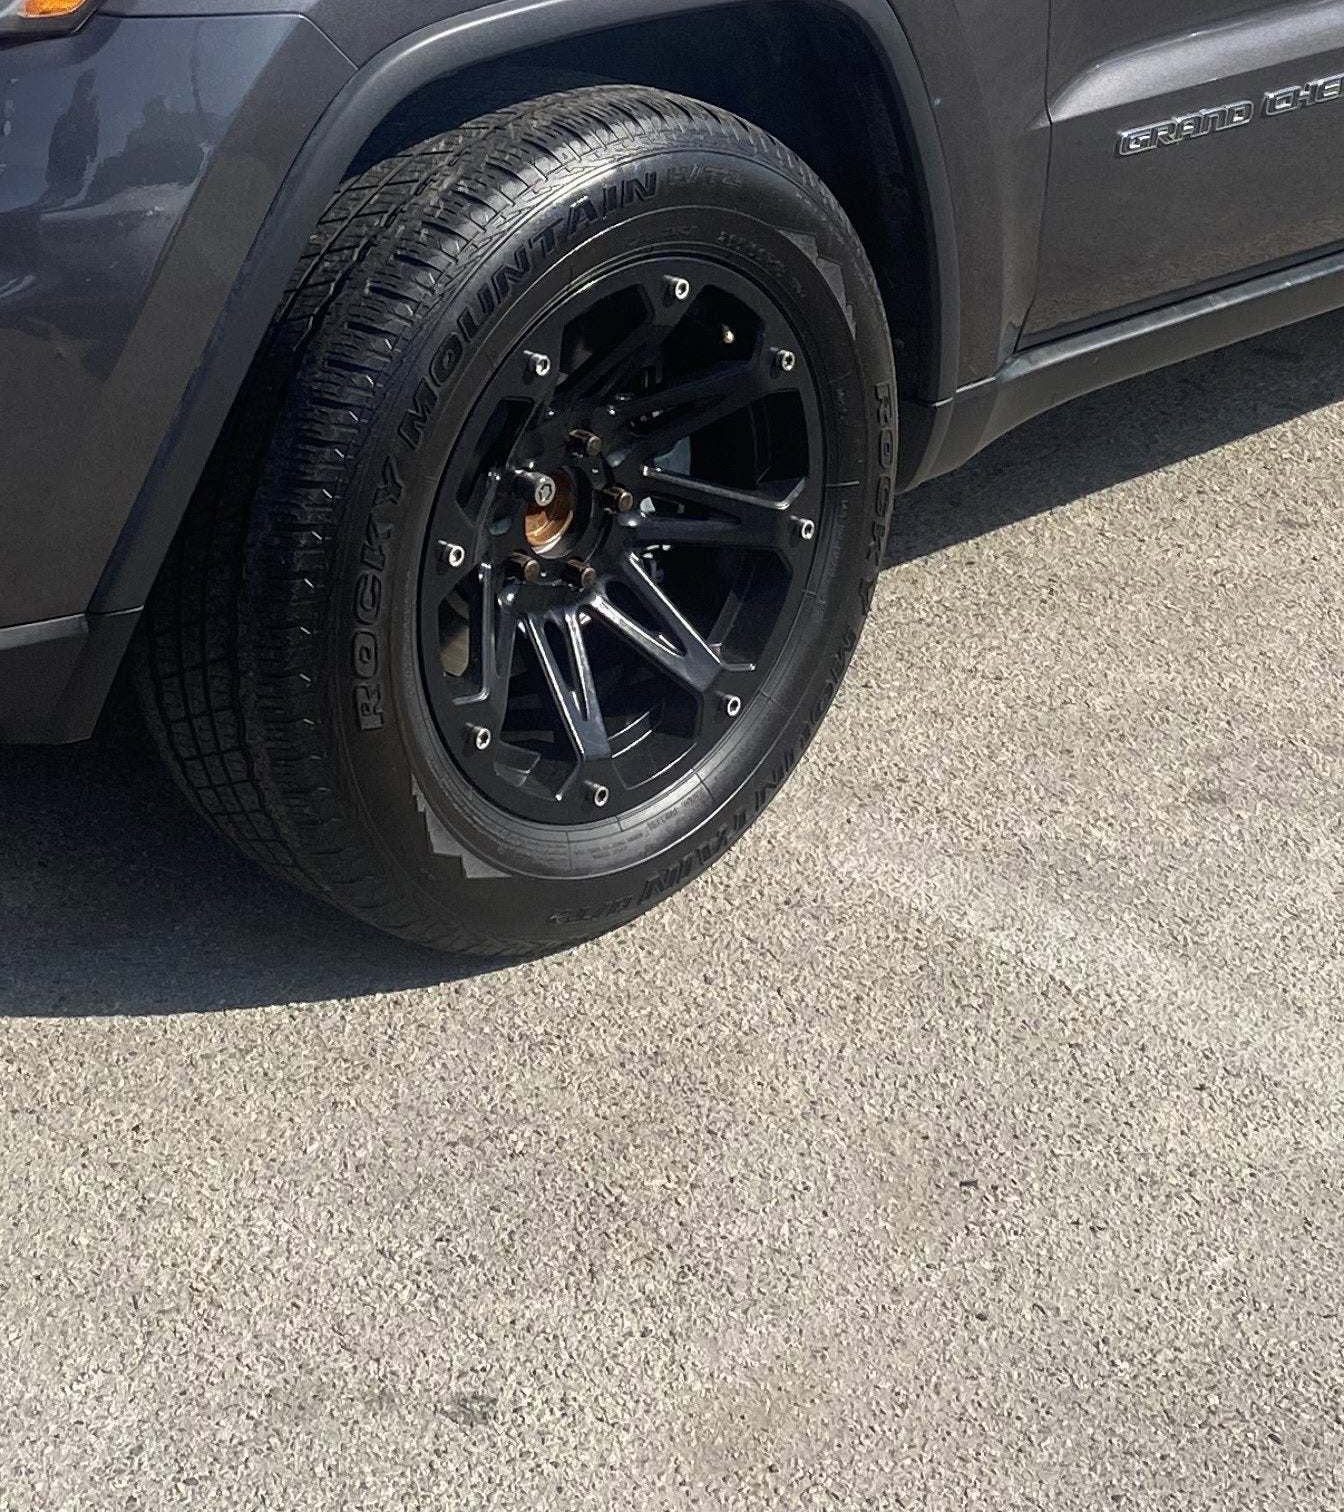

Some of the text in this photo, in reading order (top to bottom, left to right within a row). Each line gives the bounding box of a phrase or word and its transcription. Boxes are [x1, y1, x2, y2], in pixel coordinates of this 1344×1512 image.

[1115, 99, 1254, 157] GRAND
[352, 454, 404, 730] ROCKY
[398, 170, 657, 450] MOUNTAIN
